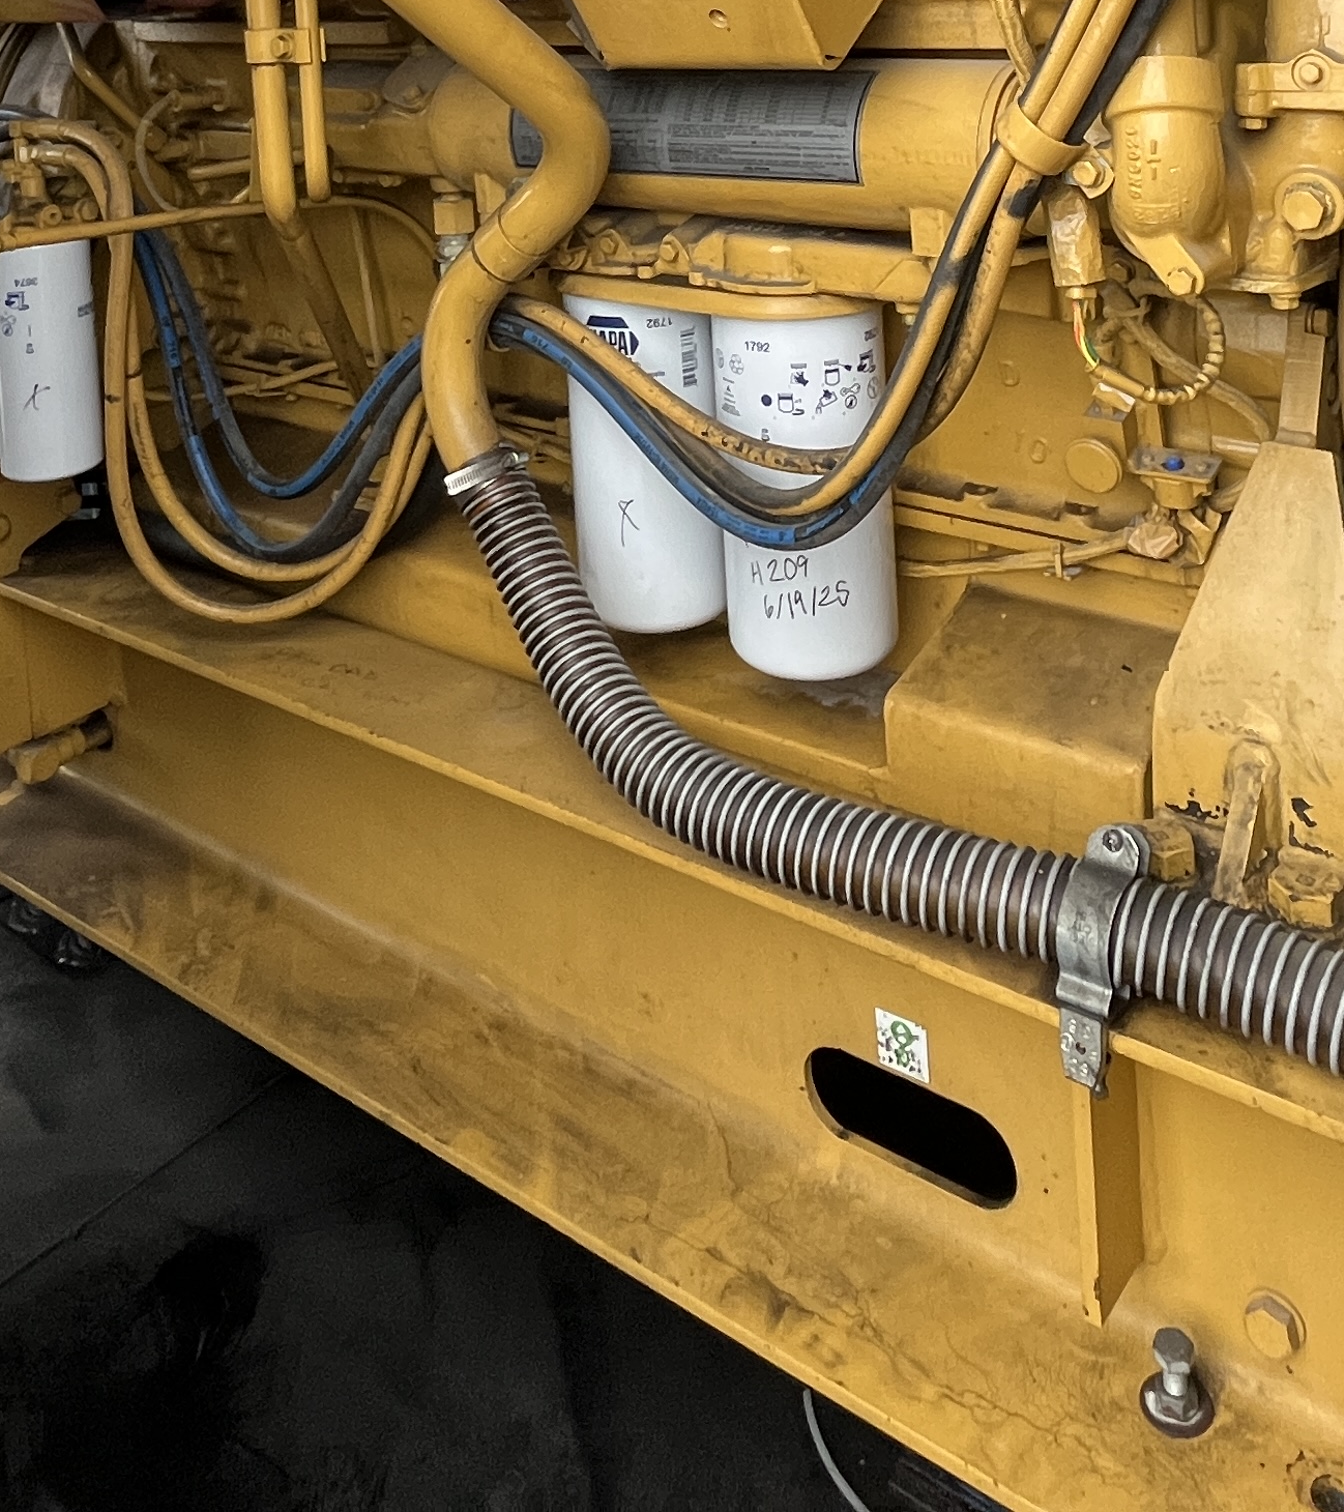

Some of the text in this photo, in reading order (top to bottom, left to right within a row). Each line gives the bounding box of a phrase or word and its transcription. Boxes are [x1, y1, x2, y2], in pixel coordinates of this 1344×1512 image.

[645, 318, 673, 329] 1792
[593, 329, 629, 356] APA
[744, 340, 771, 353] 1792
[763, 580, 850, 620] 6/19/25
